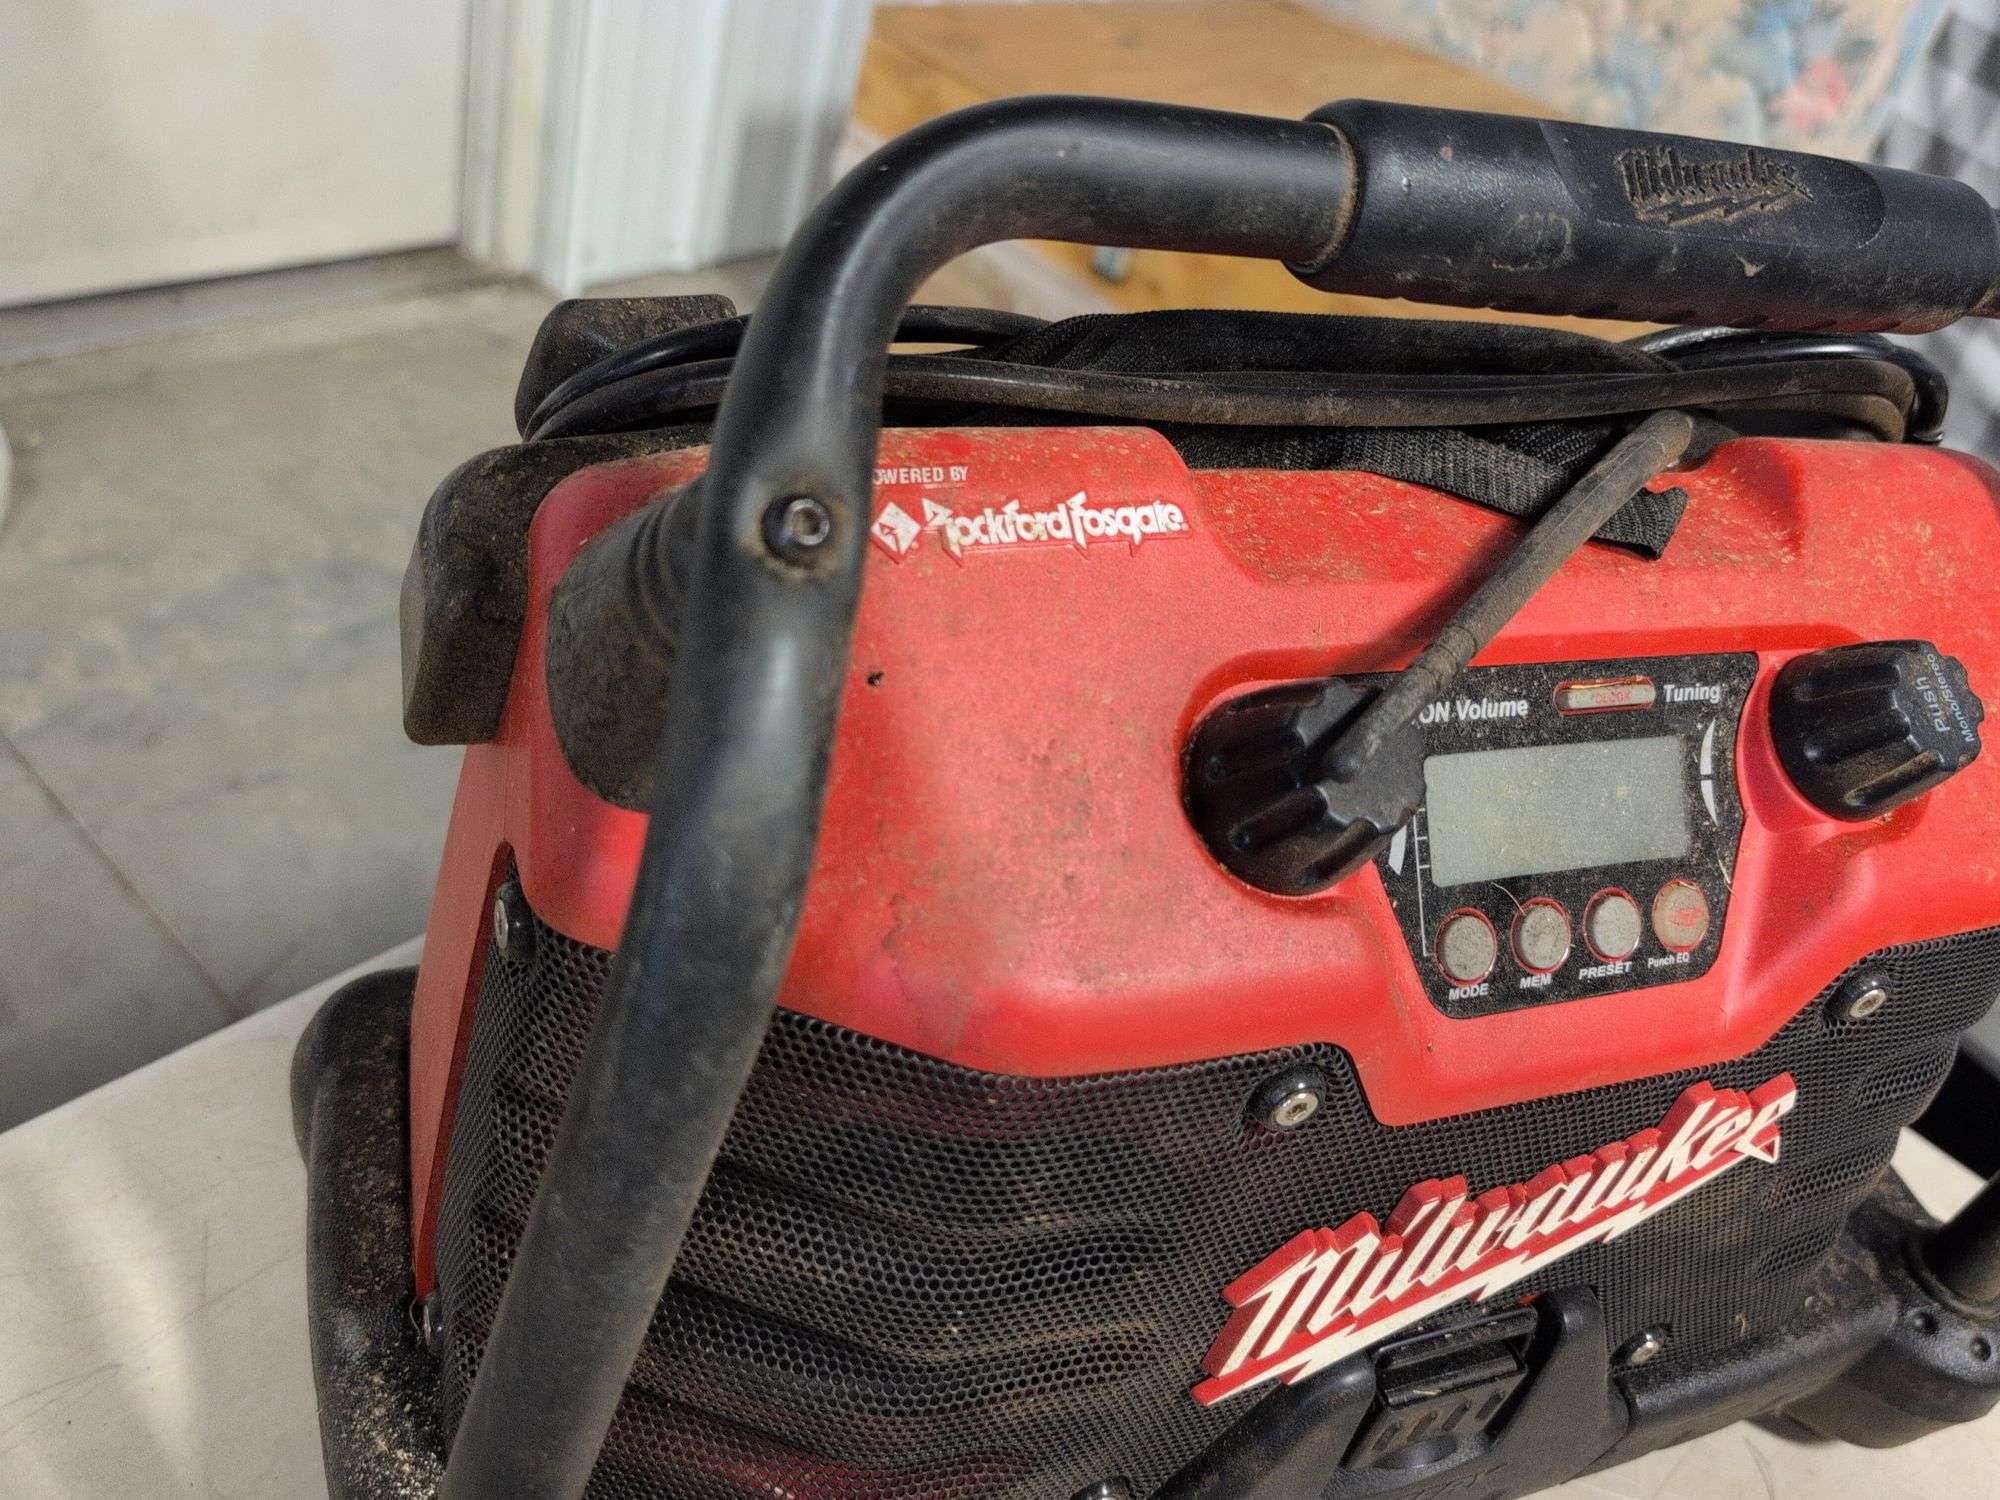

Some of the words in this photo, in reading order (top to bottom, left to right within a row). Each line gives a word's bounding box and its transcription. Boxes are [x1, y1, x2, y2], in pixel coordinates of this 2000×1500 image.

[873, 468, 944, 485] OWERED
[950, 466, 968, 482] BY
[1663, 683, 1721, 704] Tuning
[1927, 653, 1975, 743] Mono/Stereo
[1456, 698, 1528, 720] Volume
[1916, 676, 1951, 732] Push
[1647, 954, 1675, 968] Punch
[1676, 952, 1690, 963] EQ
[1519, 973, 1551, 989] MEM
[1578, 962, 1633, 980] PRESET
[1448, 982, 1489, 1000] MODE
[1194, 1074, 1797, 1395] Milwaukee
